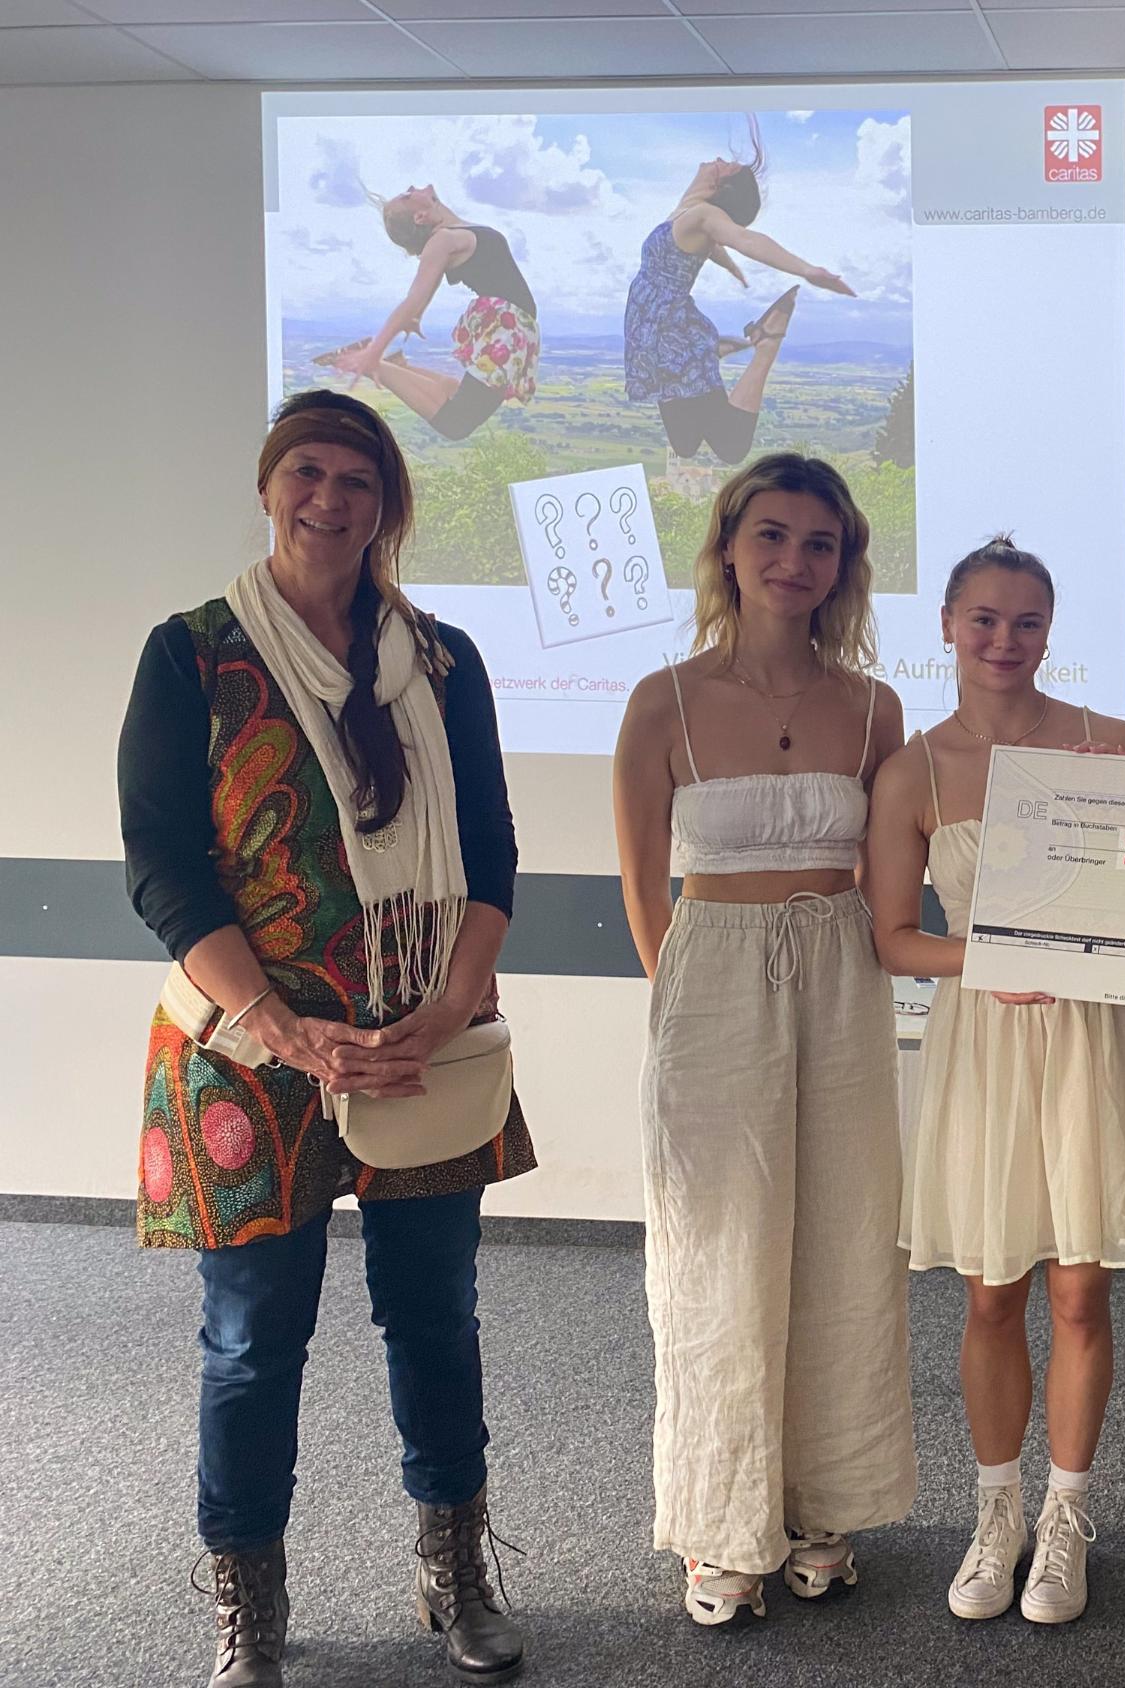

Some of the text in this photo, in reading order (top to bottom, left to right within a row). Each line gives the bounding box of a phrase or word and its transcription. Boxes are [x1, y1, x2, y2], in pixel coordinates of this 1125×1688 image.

[1049, 165, 1098, 181] caritas
[923, 206, 1107, 223] www.caritas-bamberg.de
[551, 676, 572, 691] der
[577, 677, 630, 692] Caritas.
[1054, 794, 1076, 802] Zahlen
[1087, 798, 1108, 806] gegen
[1016, 799, 1049, 820] DE
[1051, 819, 1072, 829] Betrag
[1080, 821, 1118, 832] Buchstaben
[1047, 853, 1106, 866] oder Überbringer
